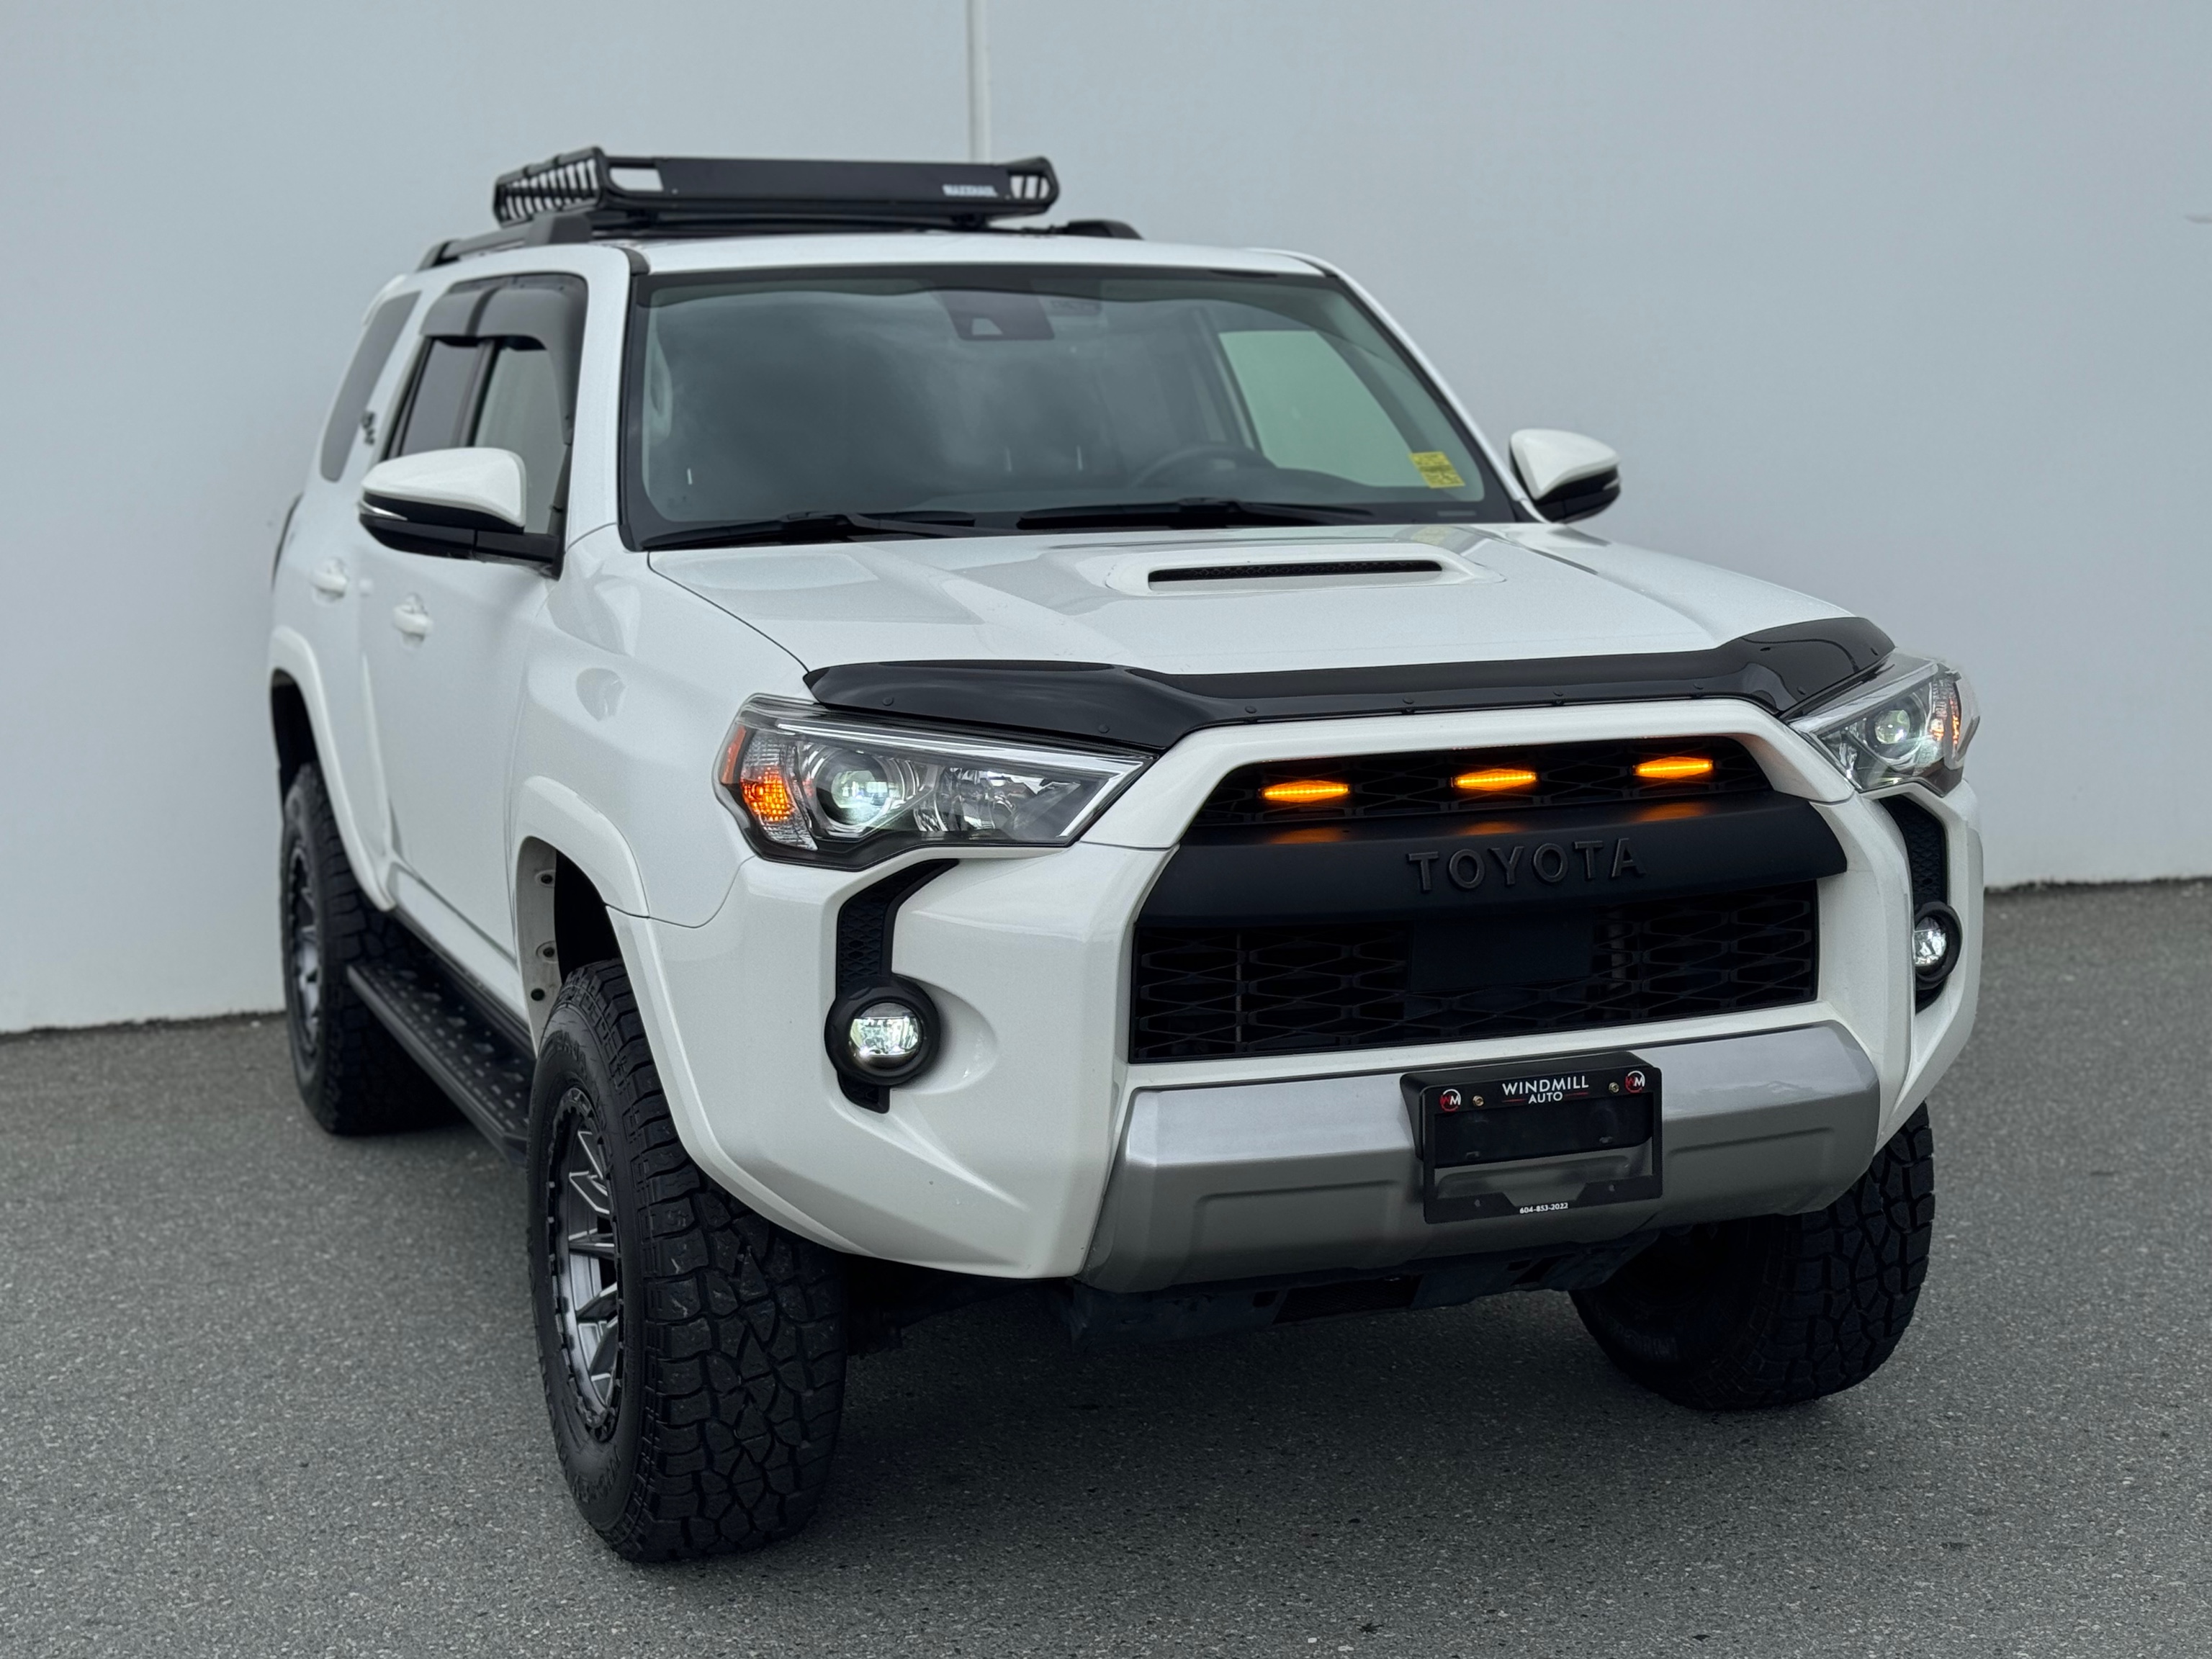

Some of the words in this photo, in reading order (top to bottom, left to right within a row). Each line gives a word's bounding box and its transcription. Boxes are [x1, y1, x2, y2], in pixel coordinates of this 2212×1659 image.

[1406, 837, 1646, 894] TOYOTA
[1501, 1075, 1590, 1097] WINDMILL
[1528, 1092, 1563, 1105] AUTO
[1519, 1202, 1569, 1215] 604-853-2022
